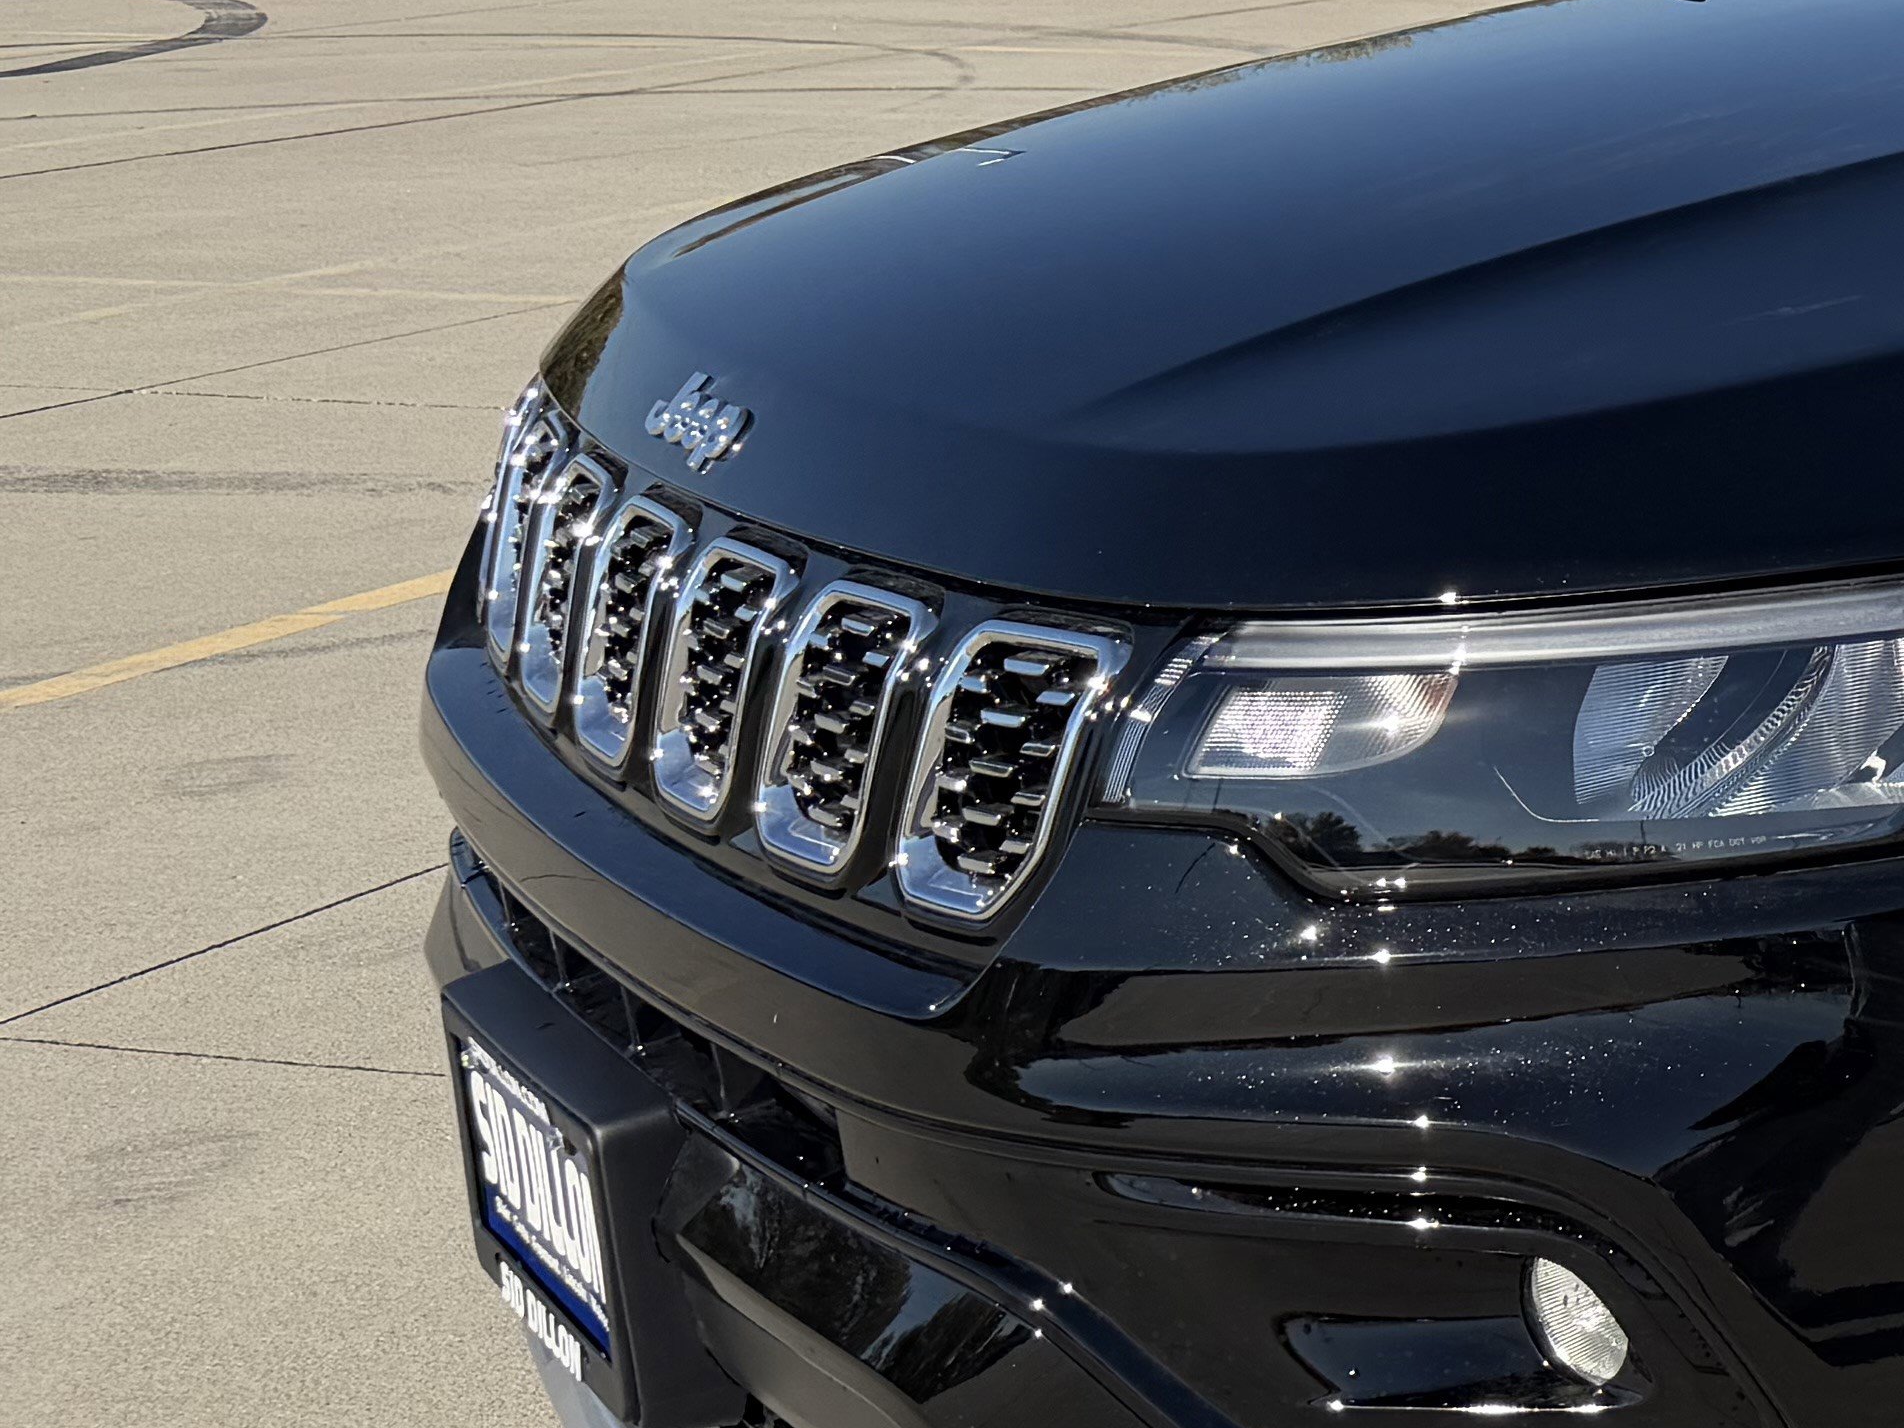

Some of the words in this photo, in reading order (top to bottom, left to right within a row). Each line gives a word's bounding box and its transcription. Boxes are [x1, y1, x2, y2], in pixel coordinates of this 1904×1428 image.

[644, 371, 745, 471] Jeep
[471, 1070, 521, 1210] SID
[512, 1108, 607, 1305] DILLON
[500, 1260, 525, 1318] SID
[526, 1289, 582, 1383] DILLON
